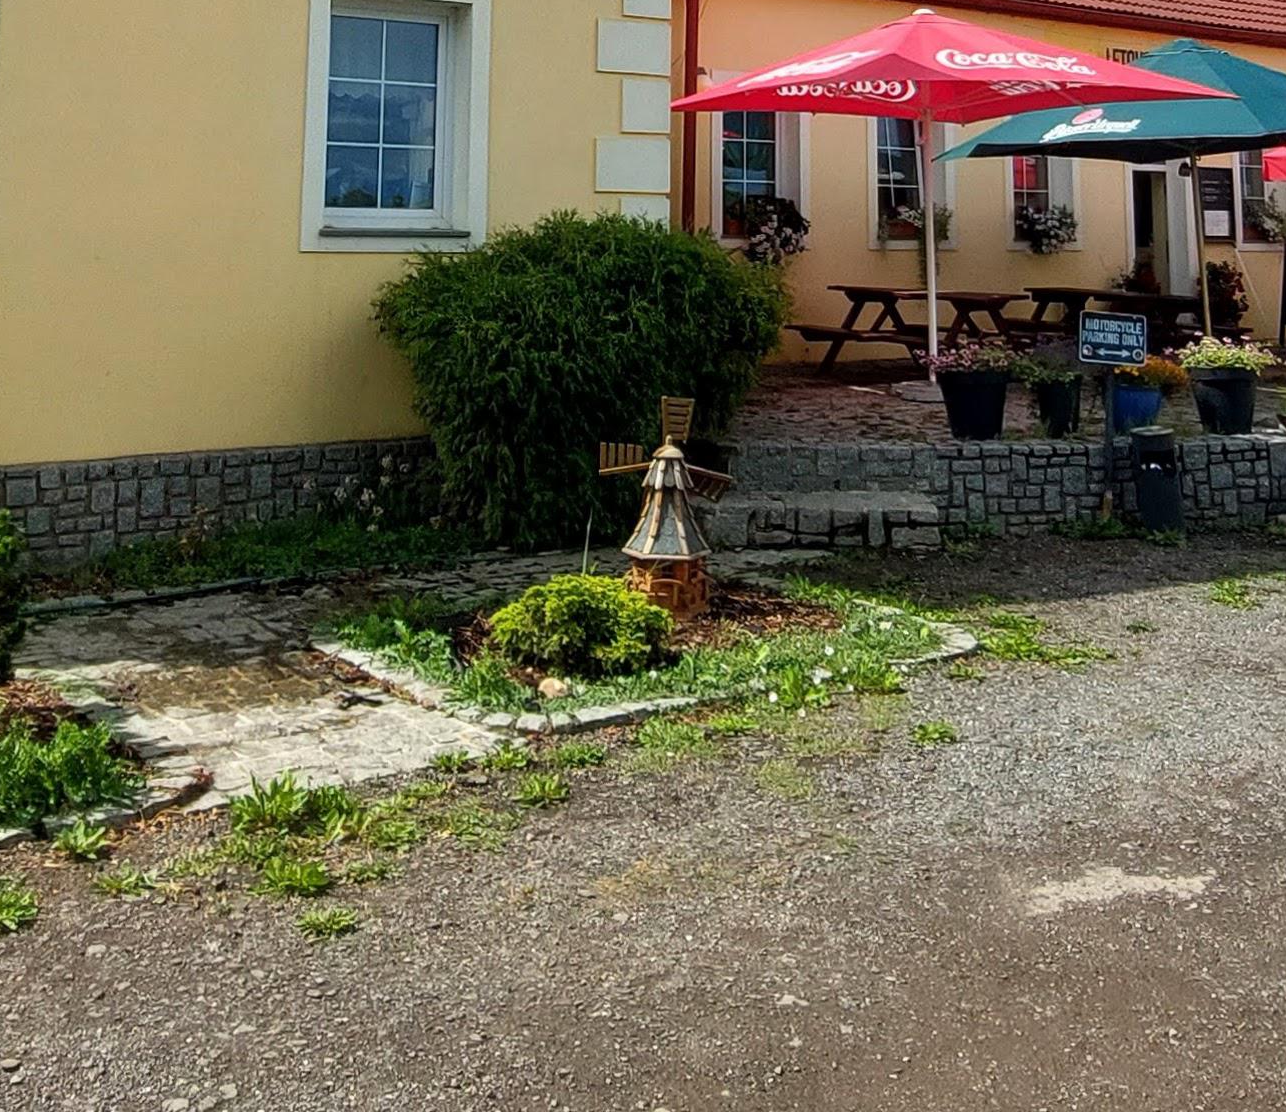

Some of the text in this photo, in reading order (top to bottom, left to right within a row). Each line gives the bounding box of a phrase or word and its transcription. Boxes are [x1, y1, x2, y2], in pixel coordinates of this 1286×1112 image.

[1085, 318, 1143, 335] MOTORCYCLE
[1082, 330, 1144, 347] PARKING ONLY
